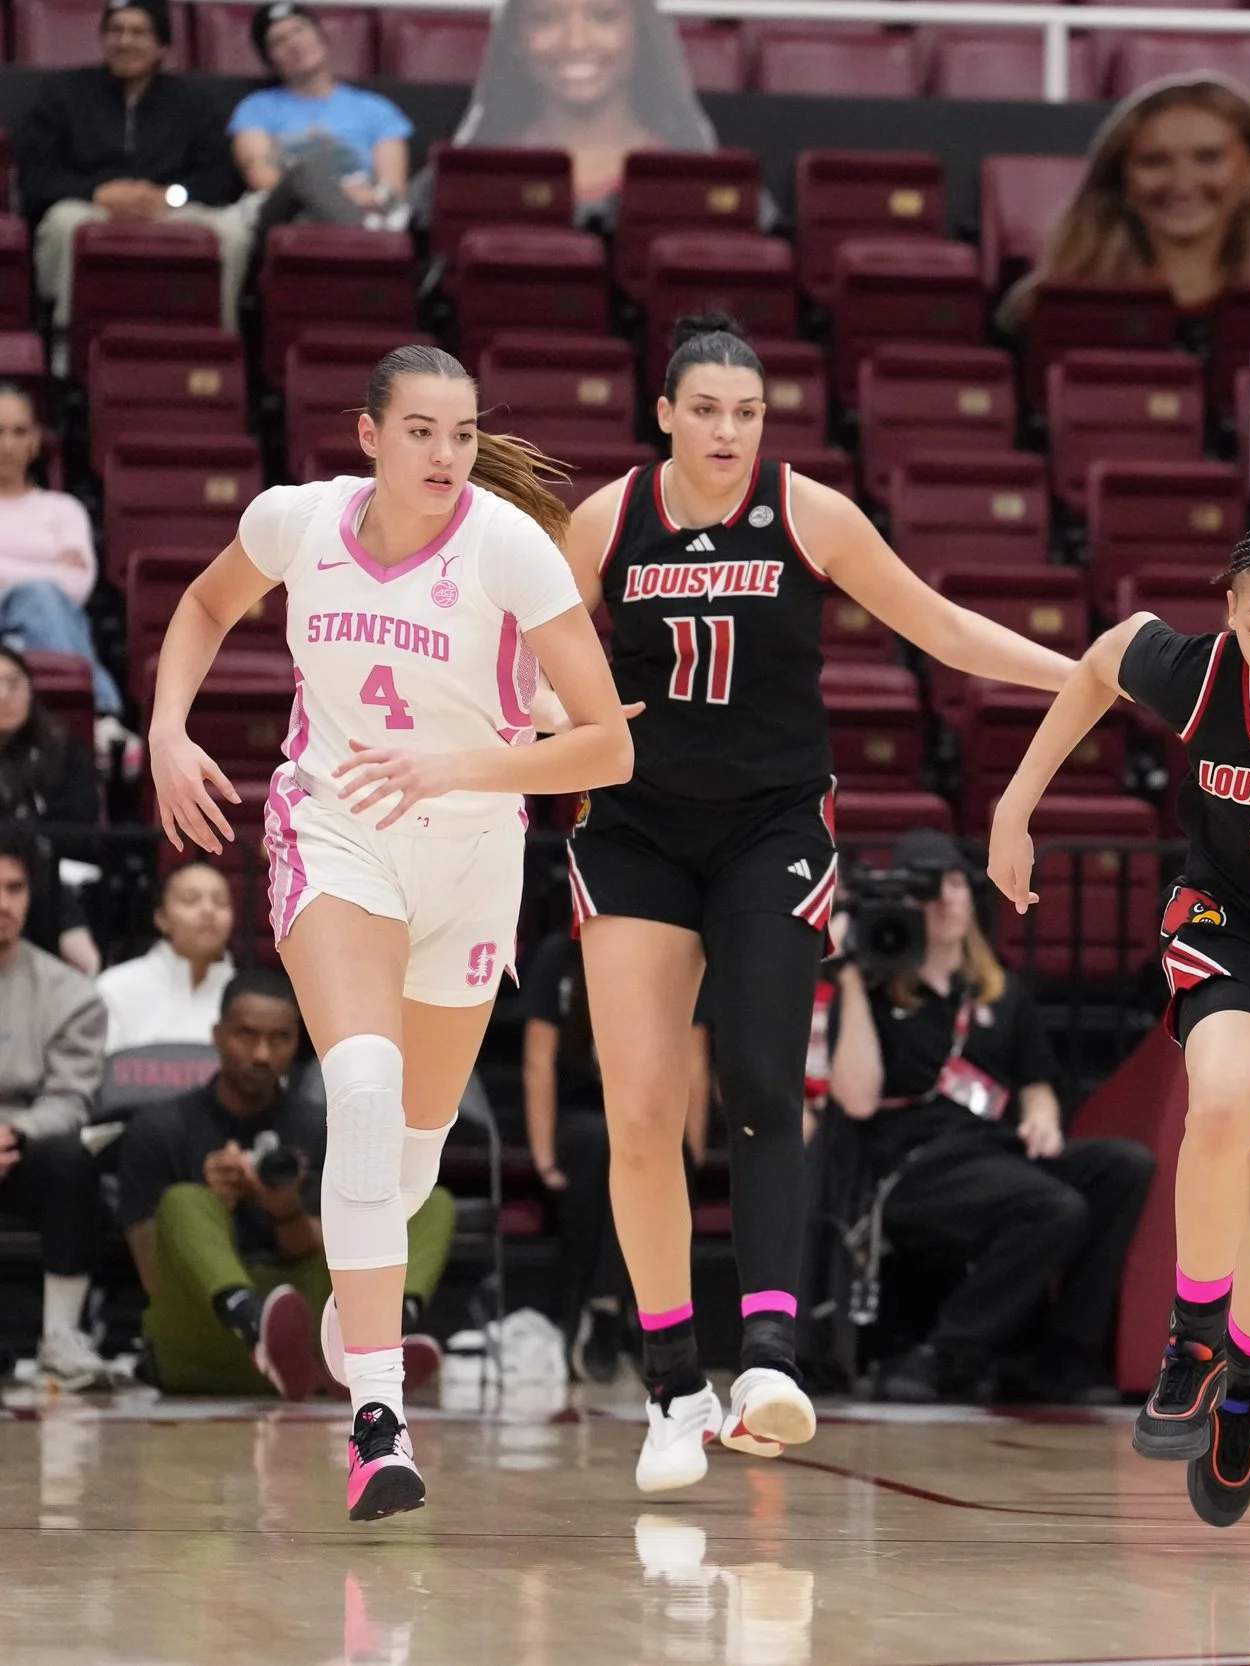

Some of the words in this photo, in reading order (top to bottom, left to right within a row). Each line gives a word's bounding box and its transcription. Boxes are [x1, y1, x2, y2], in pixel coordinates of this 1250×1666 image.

[622, 560, 785, 604] LOUISVILLE
[308, 612, 450, 662] STANFORD
[662, 615, 735, 705] 11
[359, 664, 415, 731] 4
